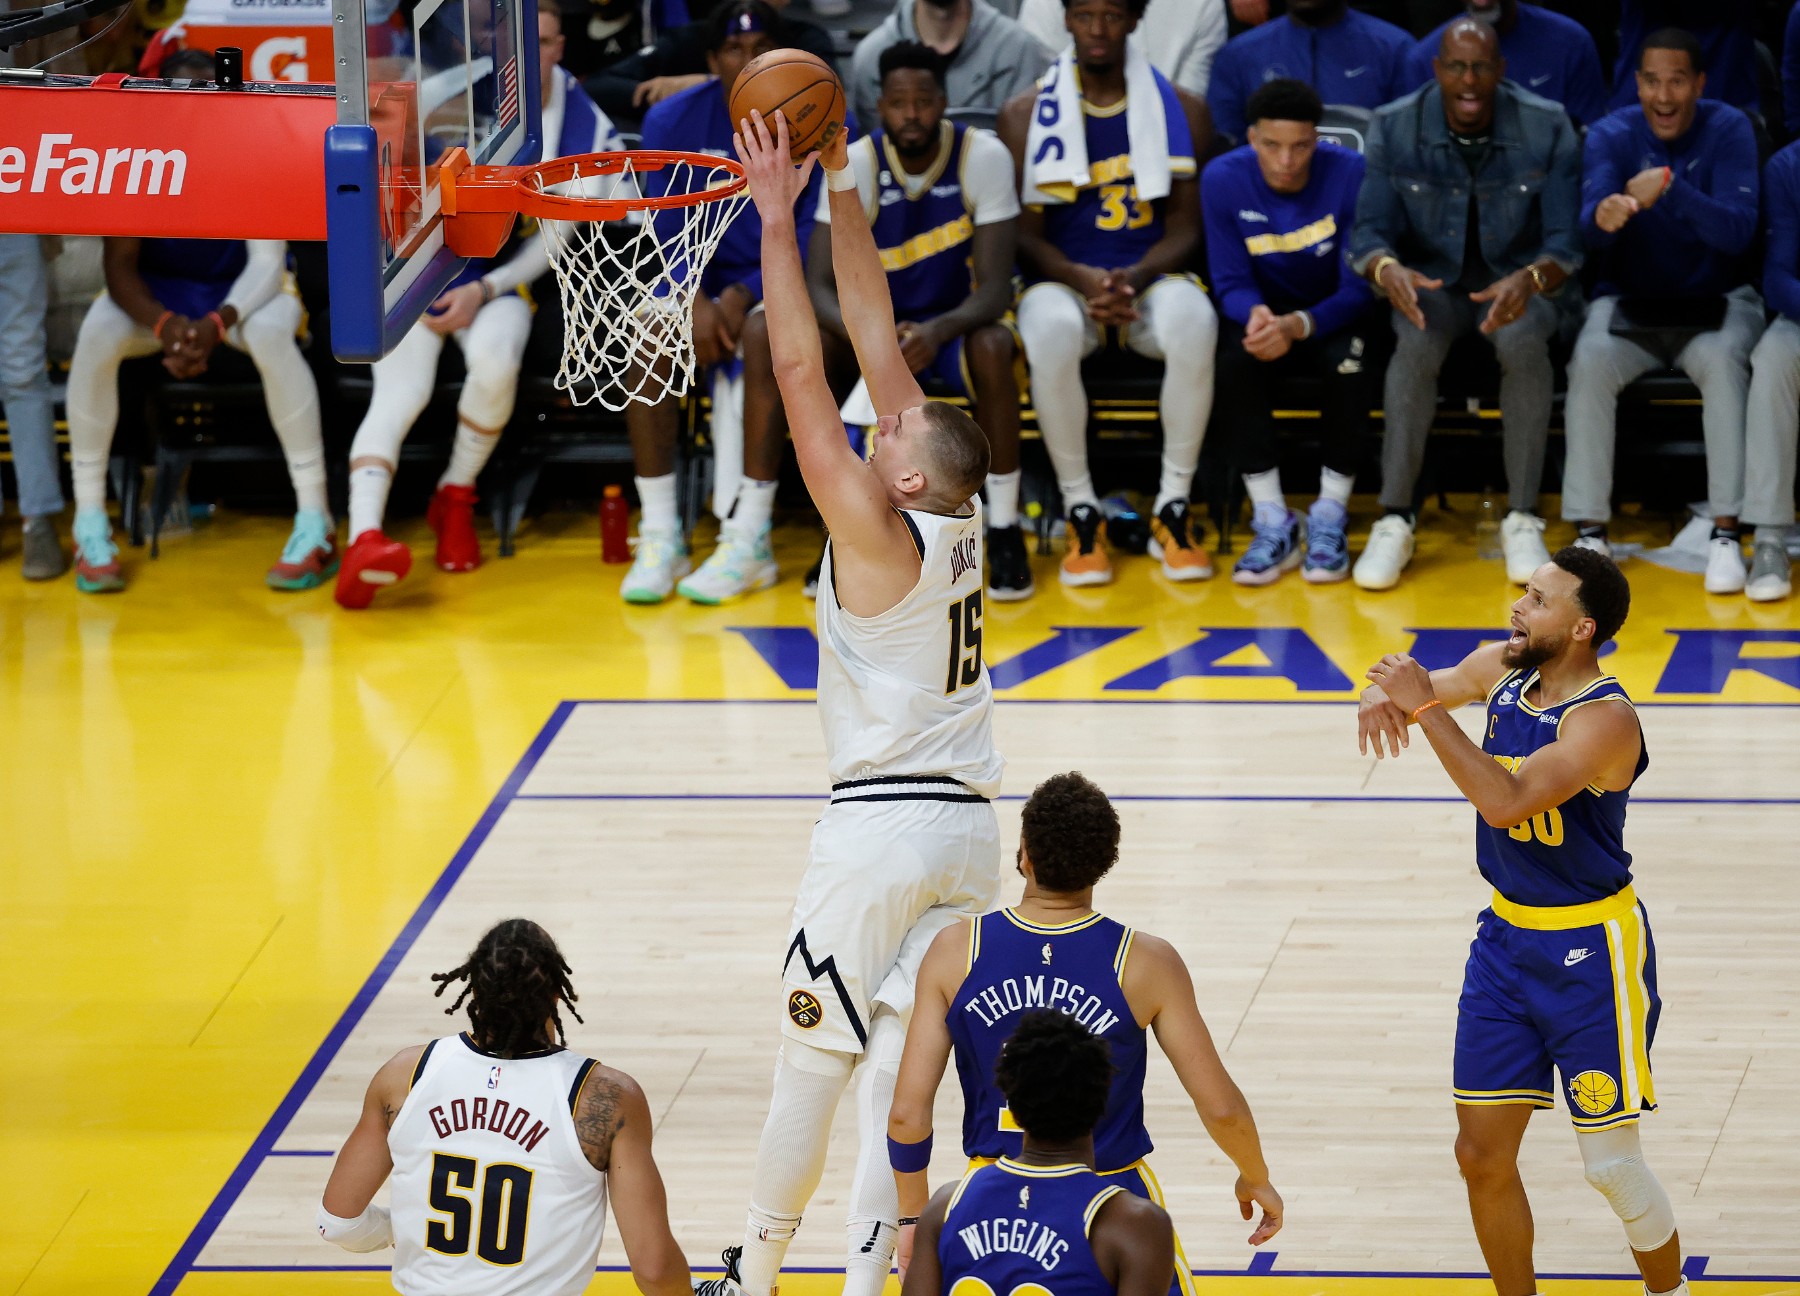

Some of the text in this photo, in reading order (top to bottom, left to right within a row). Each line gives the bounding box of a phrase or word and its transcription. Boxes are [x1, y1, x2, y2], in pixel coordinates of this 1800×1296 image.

[1095, 184, 1154, 231] 33
[950, 531, 977, 586] JOKIĆ
[944, 586, 983, 697] 15
[1508, 678, 1524, 689] 6
[1488, 713, 1499, 739] C
[964, 975, 1119, 1035] THOMPSON
[428, 1096, 550, 1153] GORDON
[424, 1150, 536, 1268] 50
[957, 1217, 1070, 1271] WIGGINS
